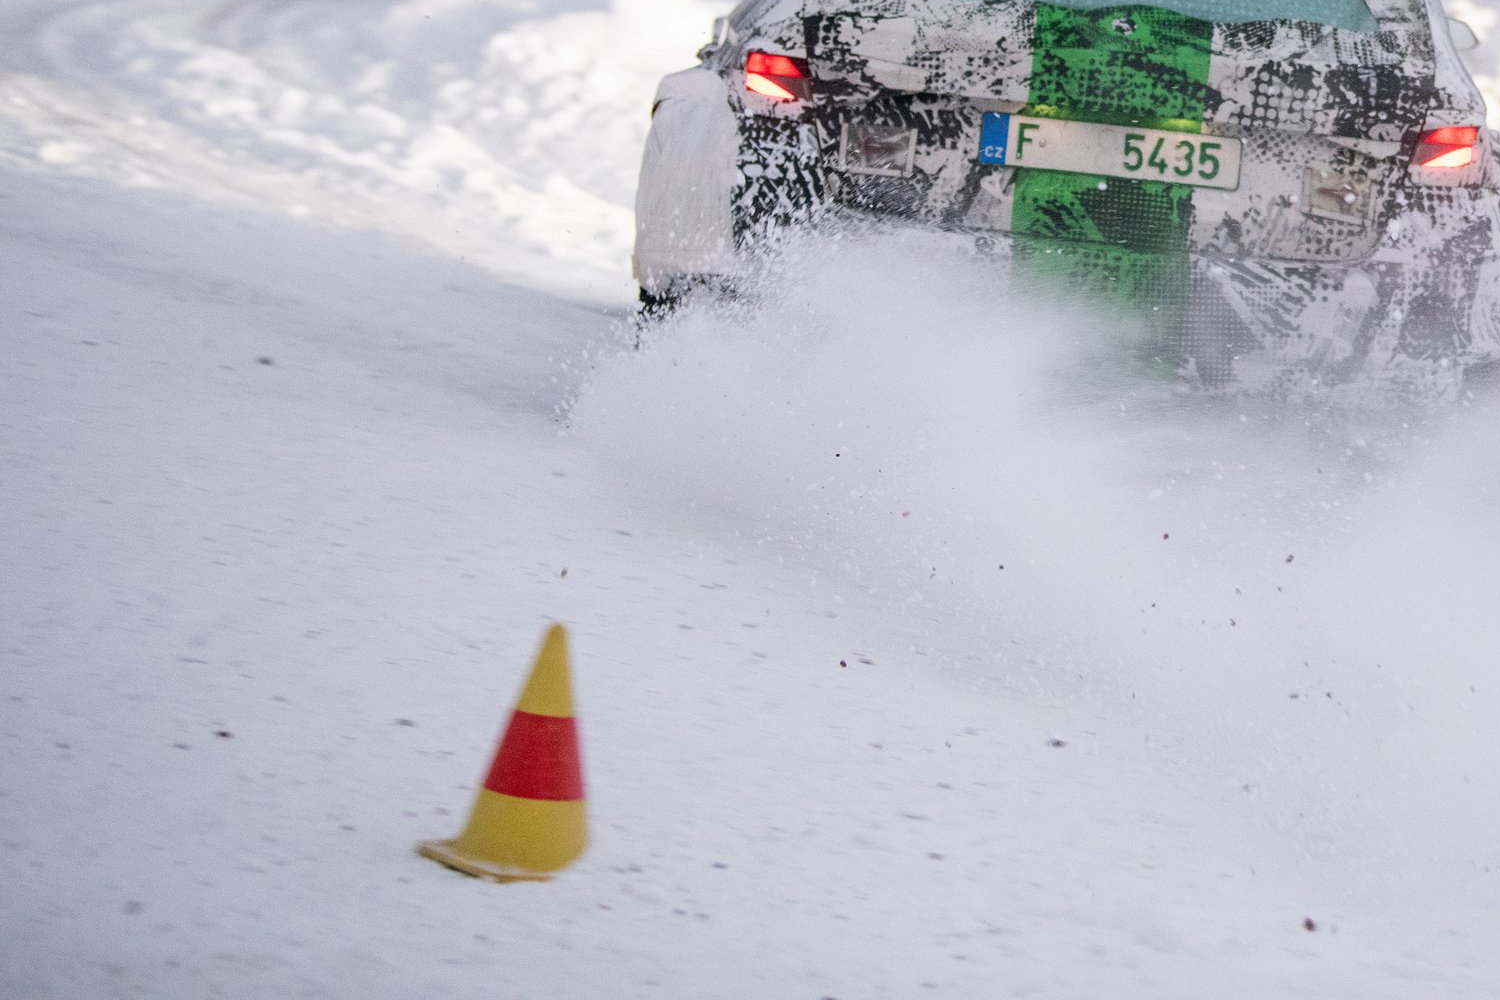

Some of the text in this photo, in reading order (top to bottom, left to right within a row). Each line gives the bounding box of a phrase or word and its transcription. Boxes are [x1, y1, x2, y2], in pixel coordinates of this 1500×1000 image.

[984, 145, 1003, 159] CZ
[1015, 123, 1222, 180] F 5435
